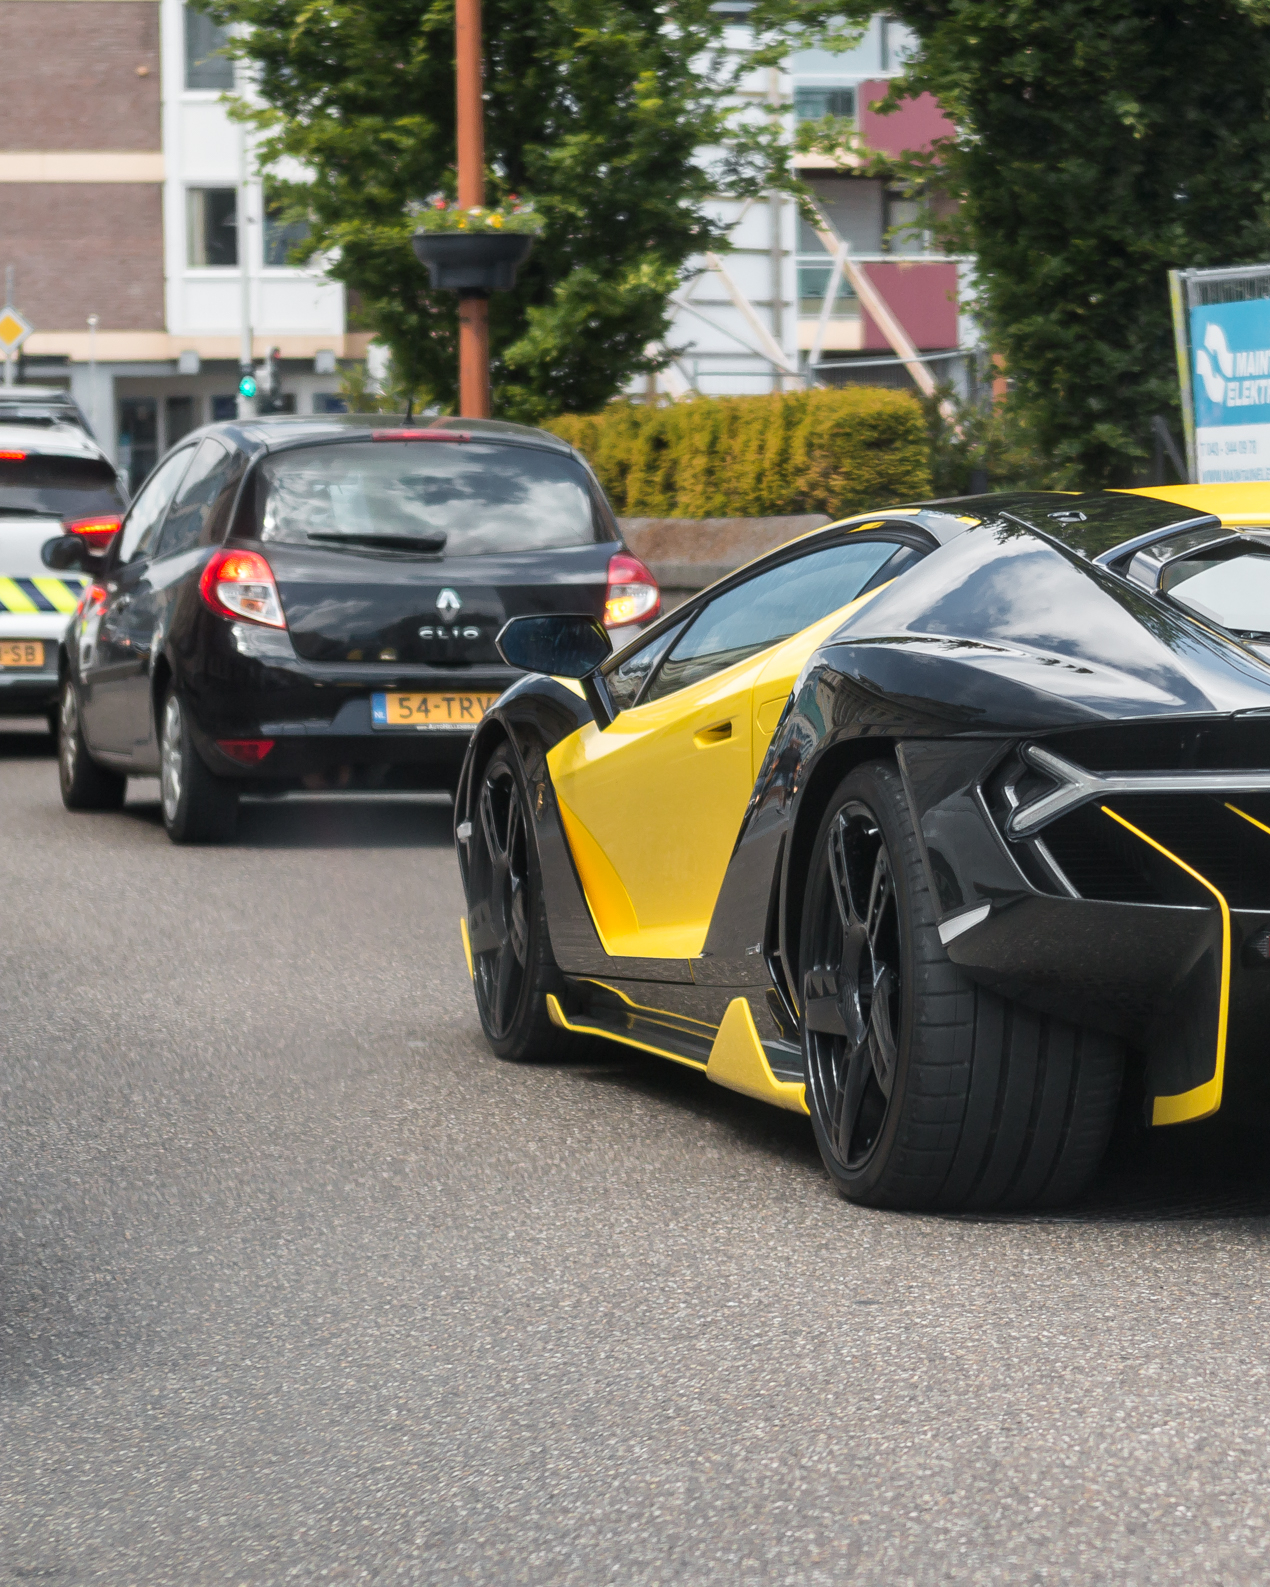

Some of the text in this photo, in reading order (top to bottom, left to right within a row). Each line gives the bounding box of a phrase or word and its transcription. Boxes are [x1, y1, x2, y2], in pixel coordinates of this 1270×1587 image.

[418, 626, 480, 640] CLIO
[0, 644, 36, 662] -SB
[399, 697, 492, 719] 54-TRV
